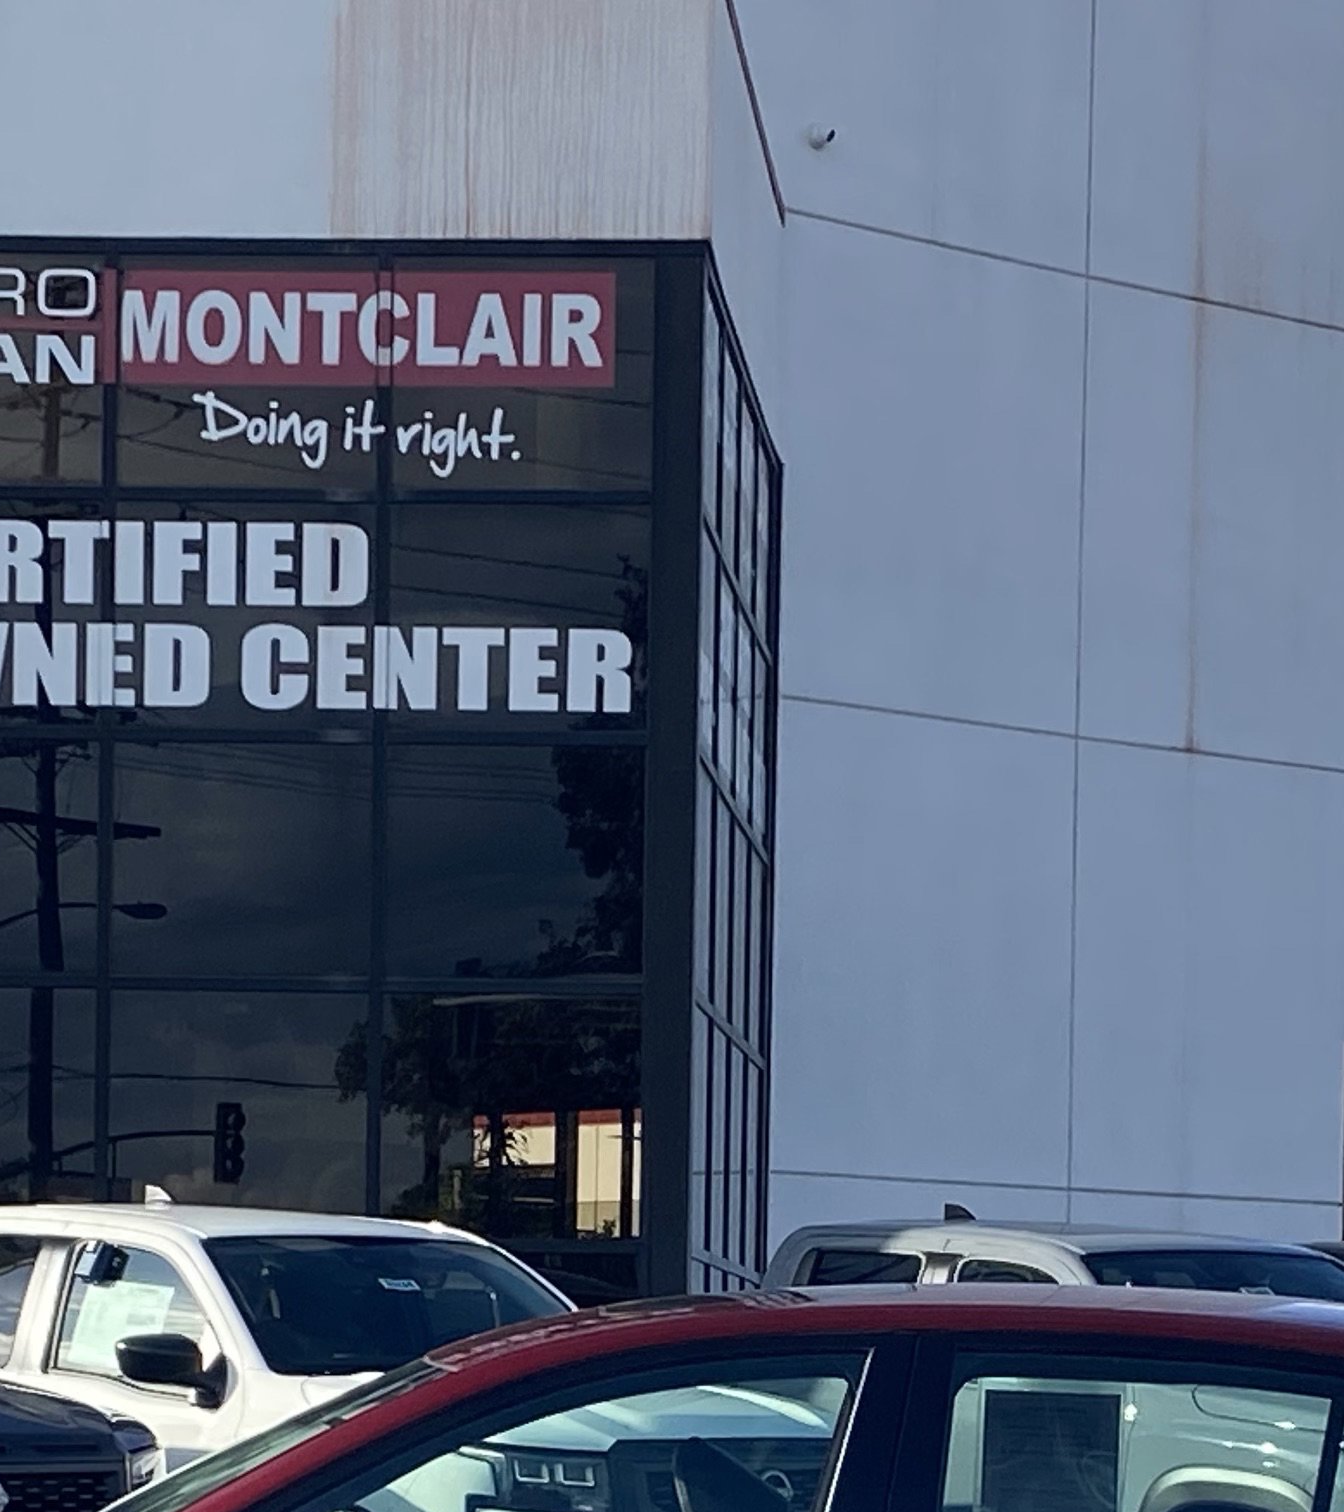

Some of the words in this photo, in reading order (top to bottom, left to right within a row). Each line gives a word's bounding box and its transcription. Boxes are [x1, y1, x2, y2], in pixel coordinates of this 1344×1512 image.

[120, 289, 604, 368] MONTCLAIR
[192, 390, 329, 470] Doing
[343, 399, 386, 452] it
[397, 407, 522, 478] right.
[239, 622, 634, 715] CENTER
